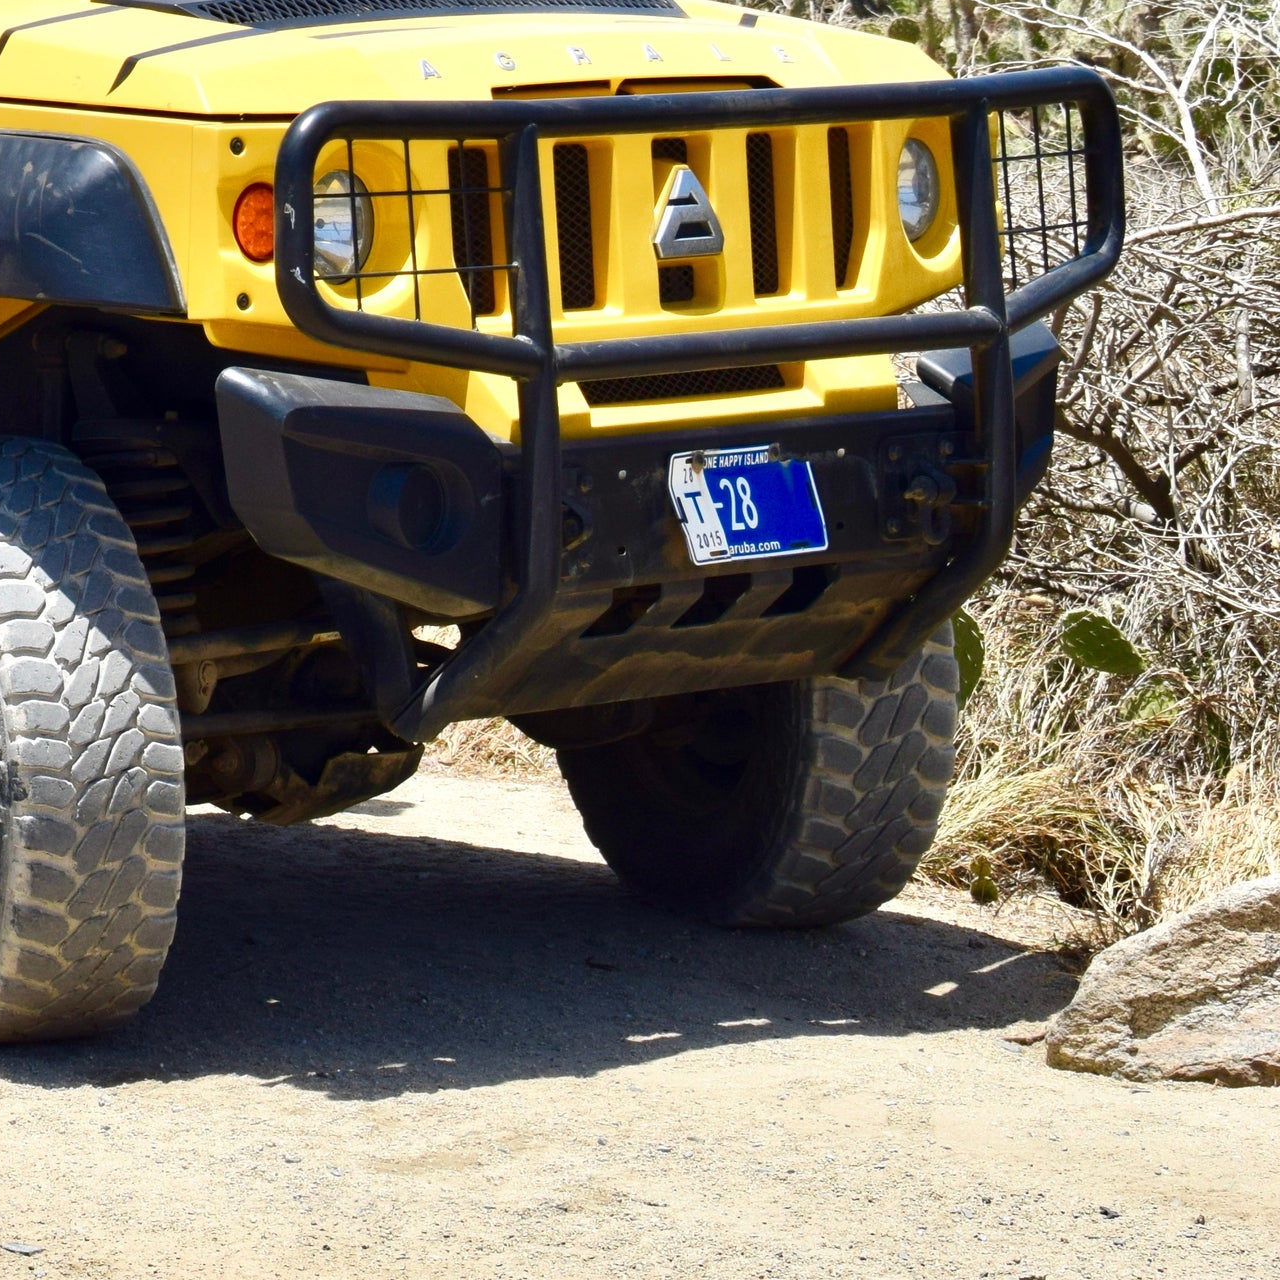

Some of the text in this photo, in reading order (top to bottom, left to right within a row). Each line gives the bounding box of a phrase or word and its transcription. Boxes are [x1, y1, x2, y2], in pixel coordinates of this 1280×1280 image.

[419, 43, 795, 80] AGRALE
[703, 450, 769, 470] ONE HAPPY ISLAND
[696, 530, 723, 549] 2015
[728, 540, 781, 555] aruba.com
